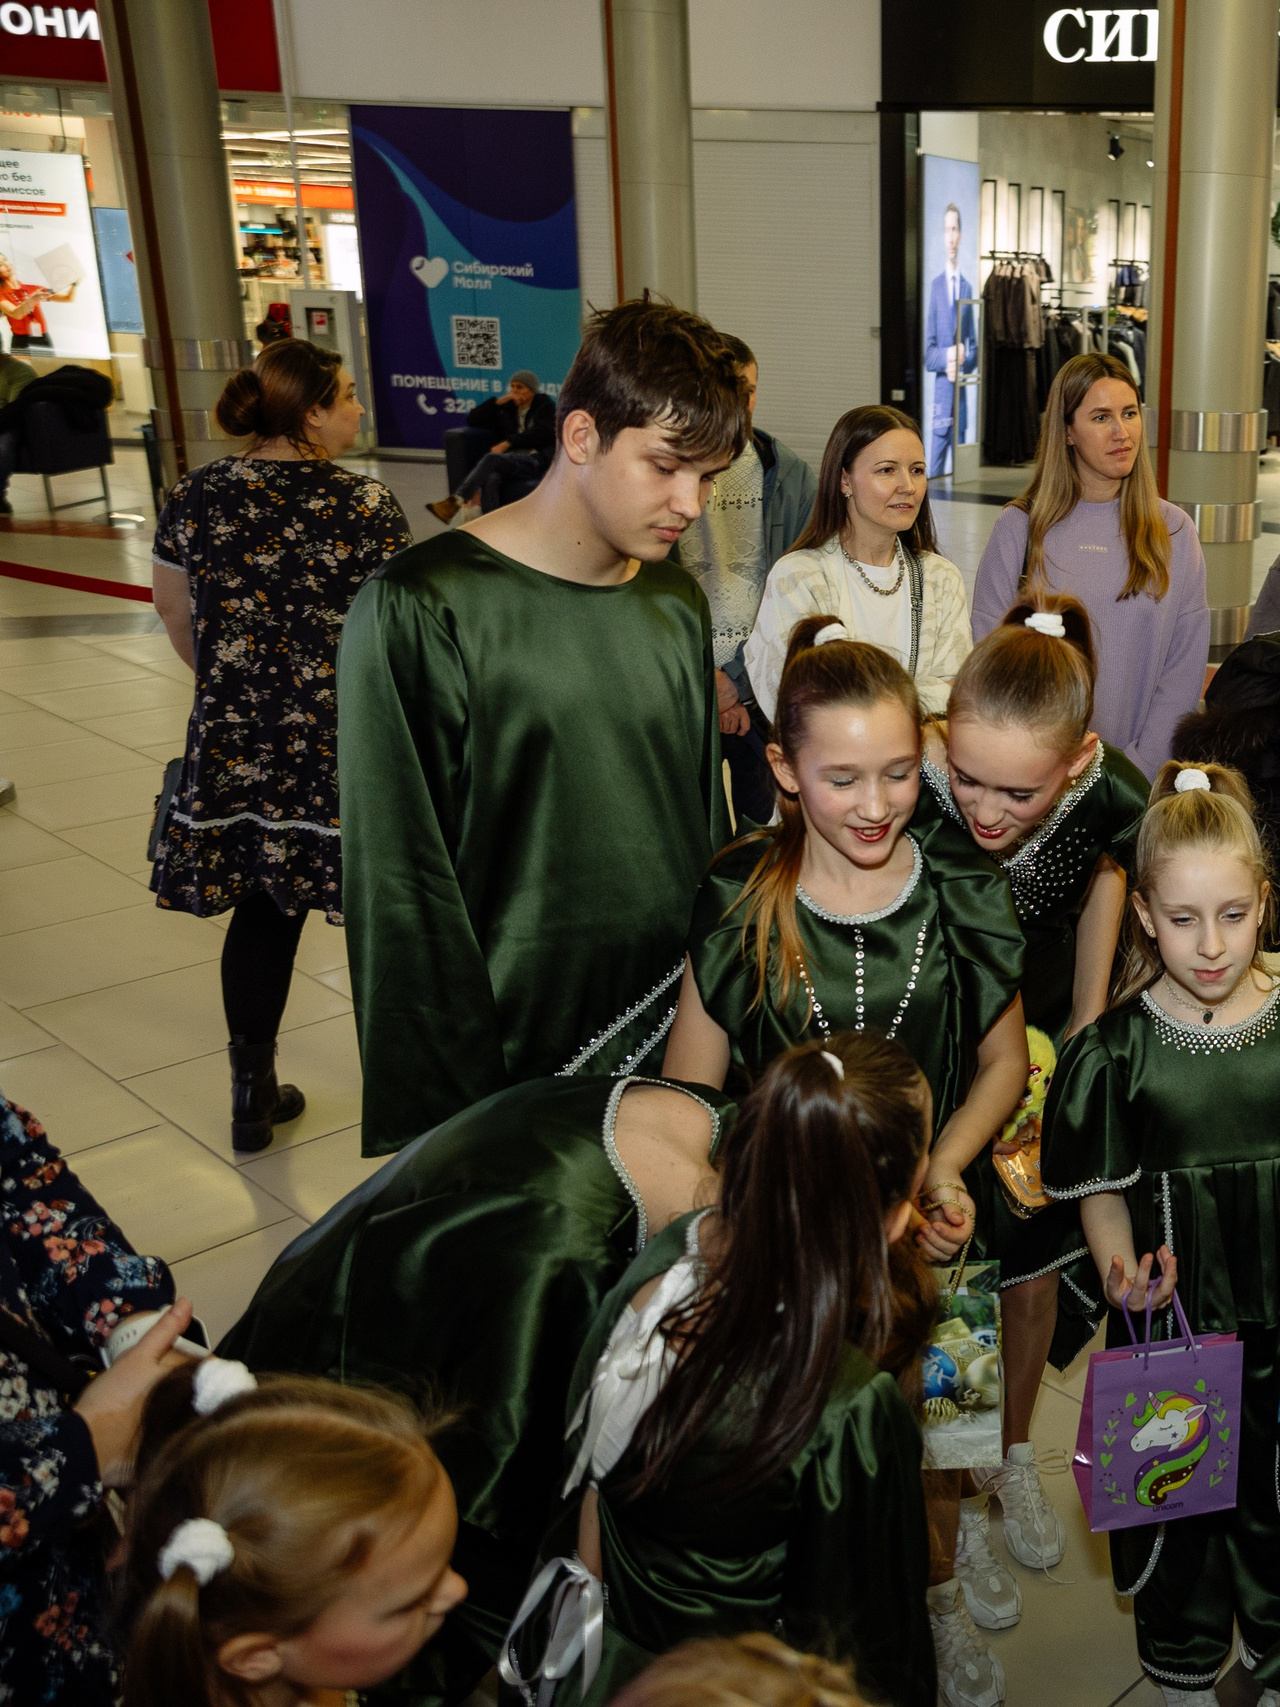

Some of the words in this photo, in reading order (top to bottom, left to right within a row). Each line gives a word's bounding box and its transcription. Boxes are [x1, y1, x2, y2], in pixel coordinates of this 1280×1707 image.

[0, 2, 100, 41] ОНИ
[11, 171, 33, 183] без
[452, 261, 535, 278] Сибирский
[453, 276, 493, 290] Молл
[391, 373, 490, 392] ПОМЕЩЕНИЕ
[492, 379, 503, 393] В
